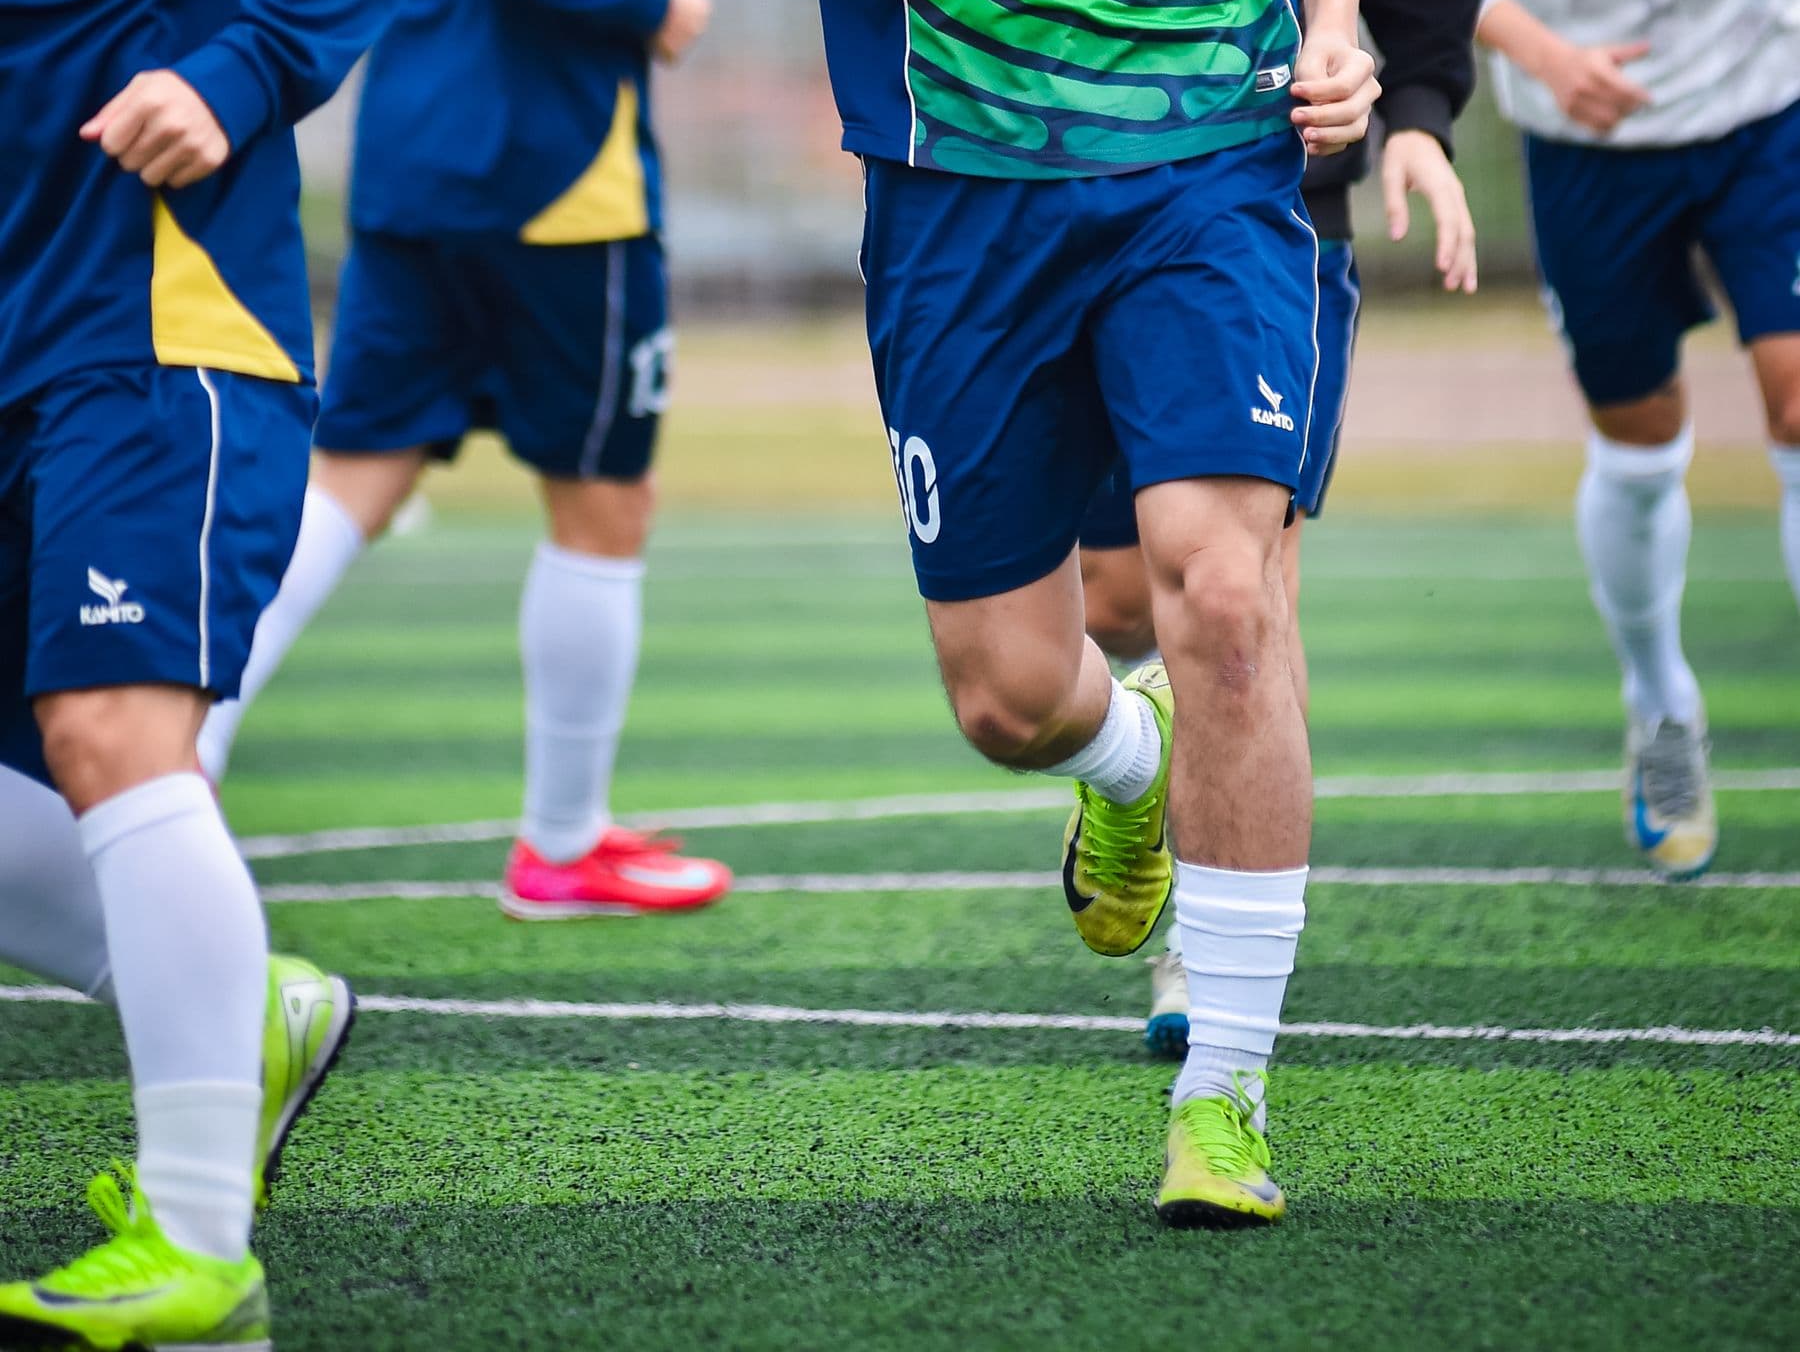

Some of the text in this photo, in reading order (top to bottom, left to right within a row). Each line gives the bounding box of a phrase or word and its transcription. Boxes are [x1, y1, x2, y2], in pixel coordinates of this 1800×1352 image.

[1250, 406, 1295, 431] KAMITO
[889, 426, 941, 544] 0
[79, 603, 145, 626] KAMITO
